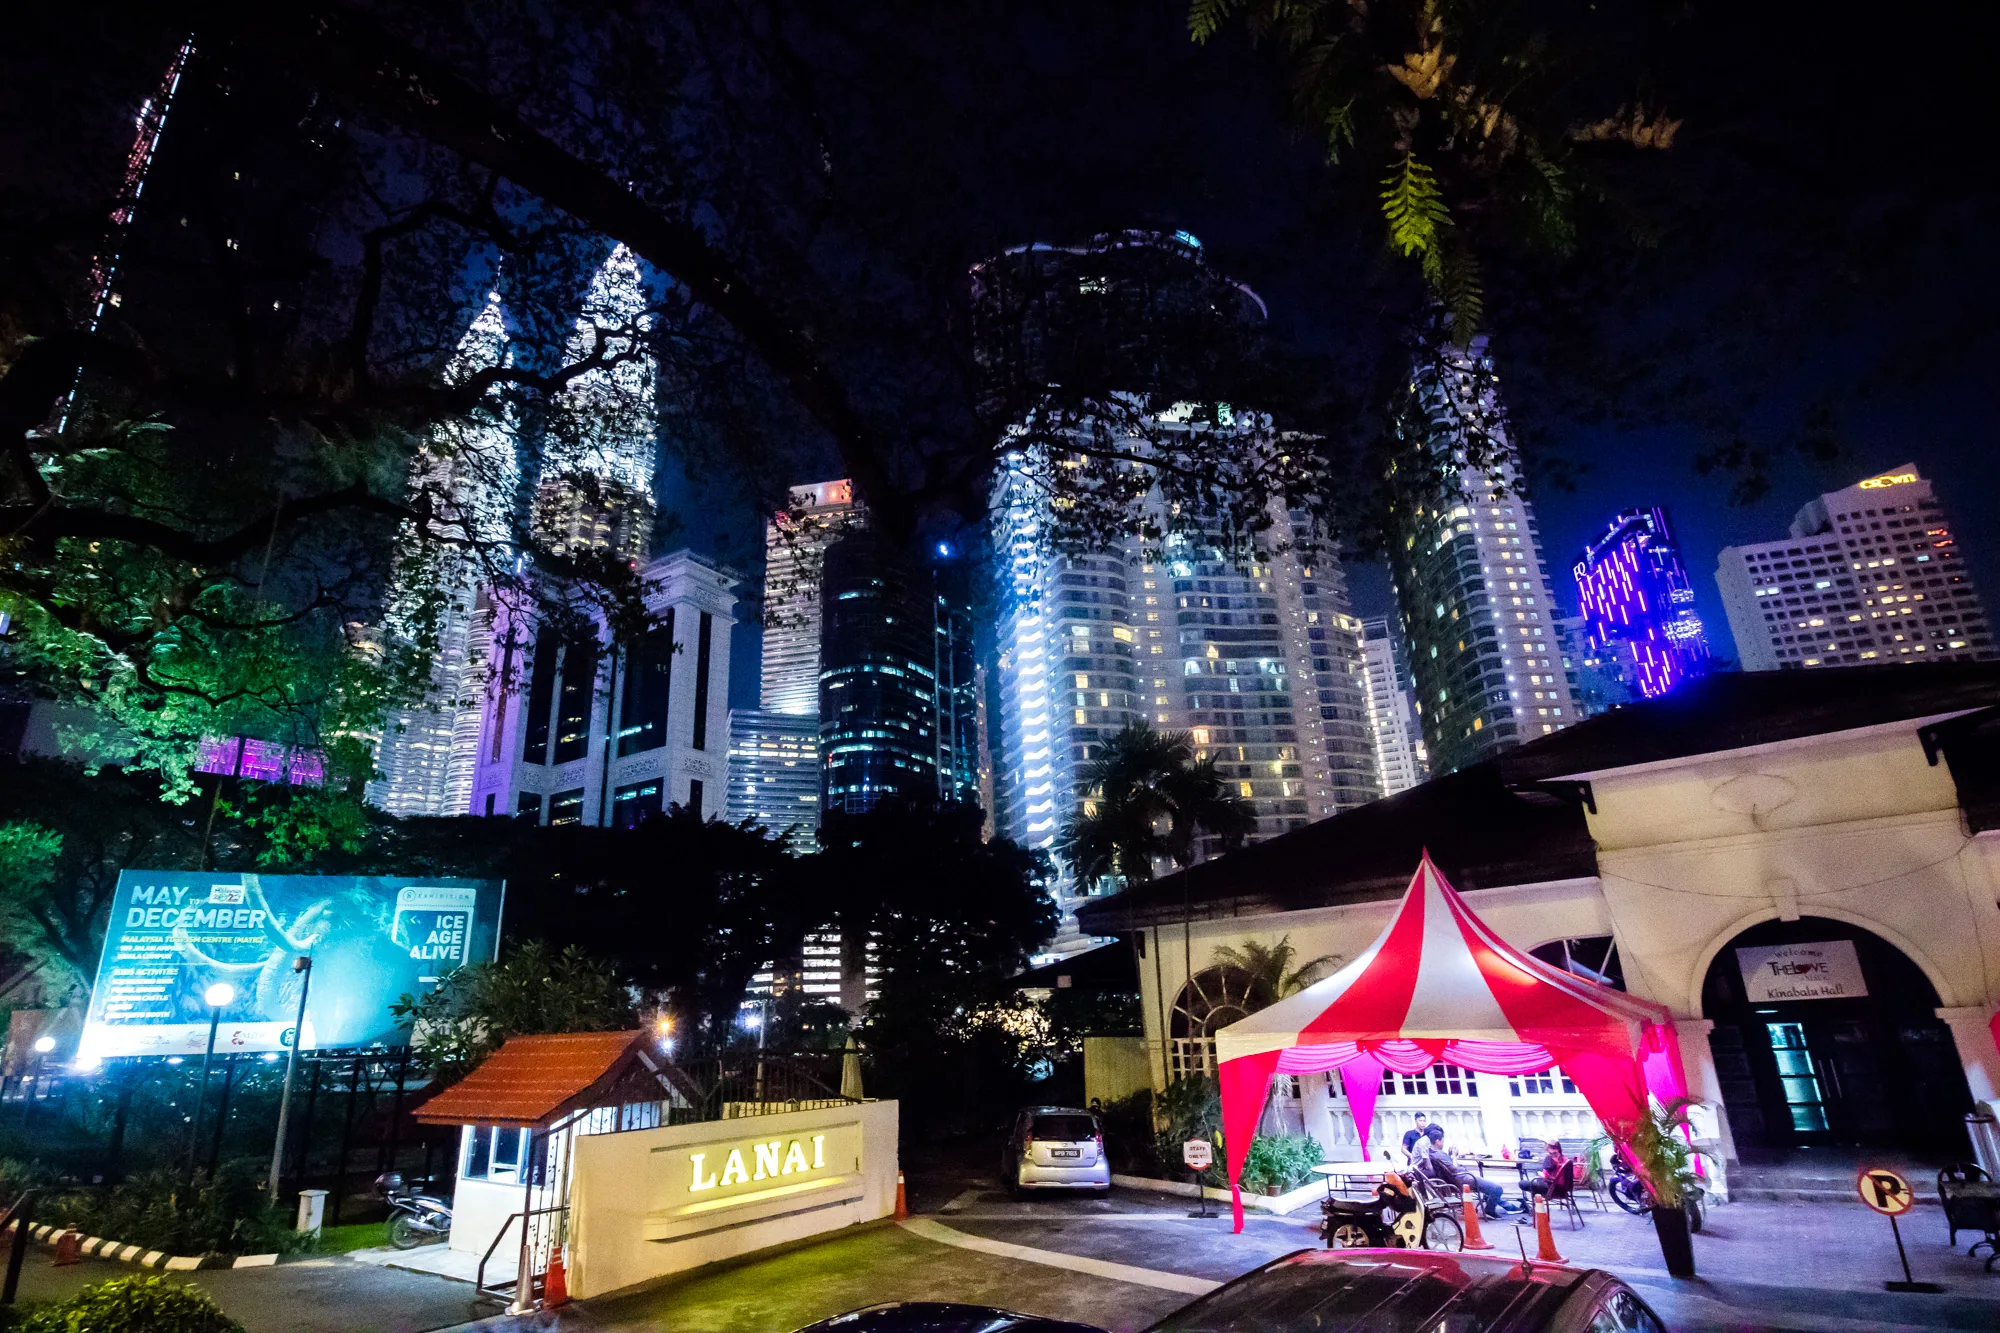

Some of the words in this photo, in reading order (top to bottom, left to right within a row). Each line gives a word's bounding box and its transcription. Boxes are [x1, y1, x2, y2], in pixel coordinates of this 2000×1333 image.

[1573, 562, 1587, 581] EQ
[131, 886, 189, 905] MAY
[126, 908, 266, 929] DECEMBER
[436, 915, 465, 929] ICE
[201, 936, 234, 944] CENTRE
[426, 930, 463, 944] AGE
[409, 945, 461, 960] ALIVE
[1767, 985, 1818, 998] Kinabalu
[1820, 983, 1845, 995] Hall
[689, 1135, 825, 1192] LANAI
